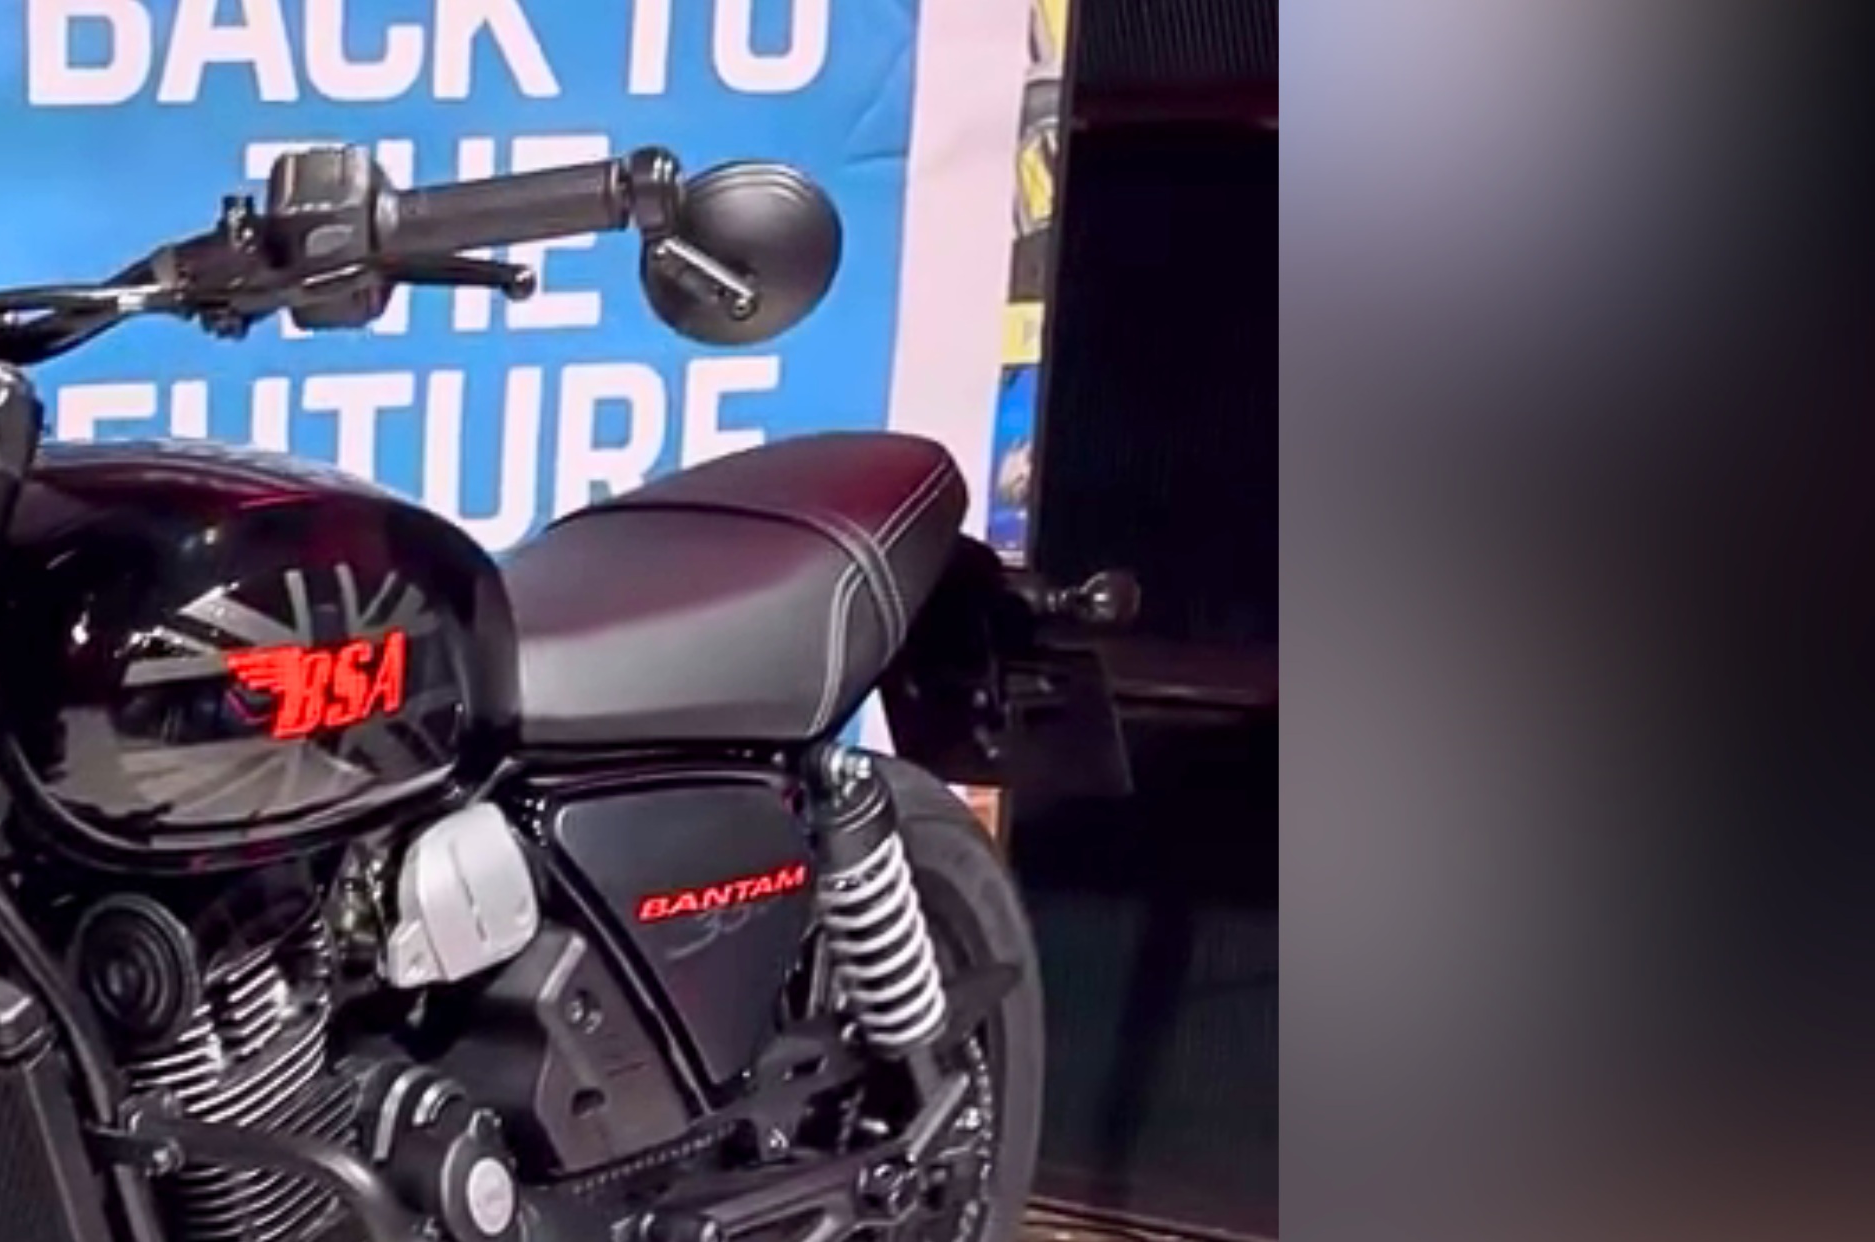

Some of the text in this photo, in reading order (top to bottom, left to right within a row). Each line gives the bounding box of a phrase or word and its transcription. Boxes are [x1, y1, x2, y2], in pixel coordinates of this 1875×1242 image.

[246, 135, 610, 339] HE
[56, 355, 780, 554] TURE
[270, 626, 408, 740] BSA
[637, 864, 807, 920] BANTAM
